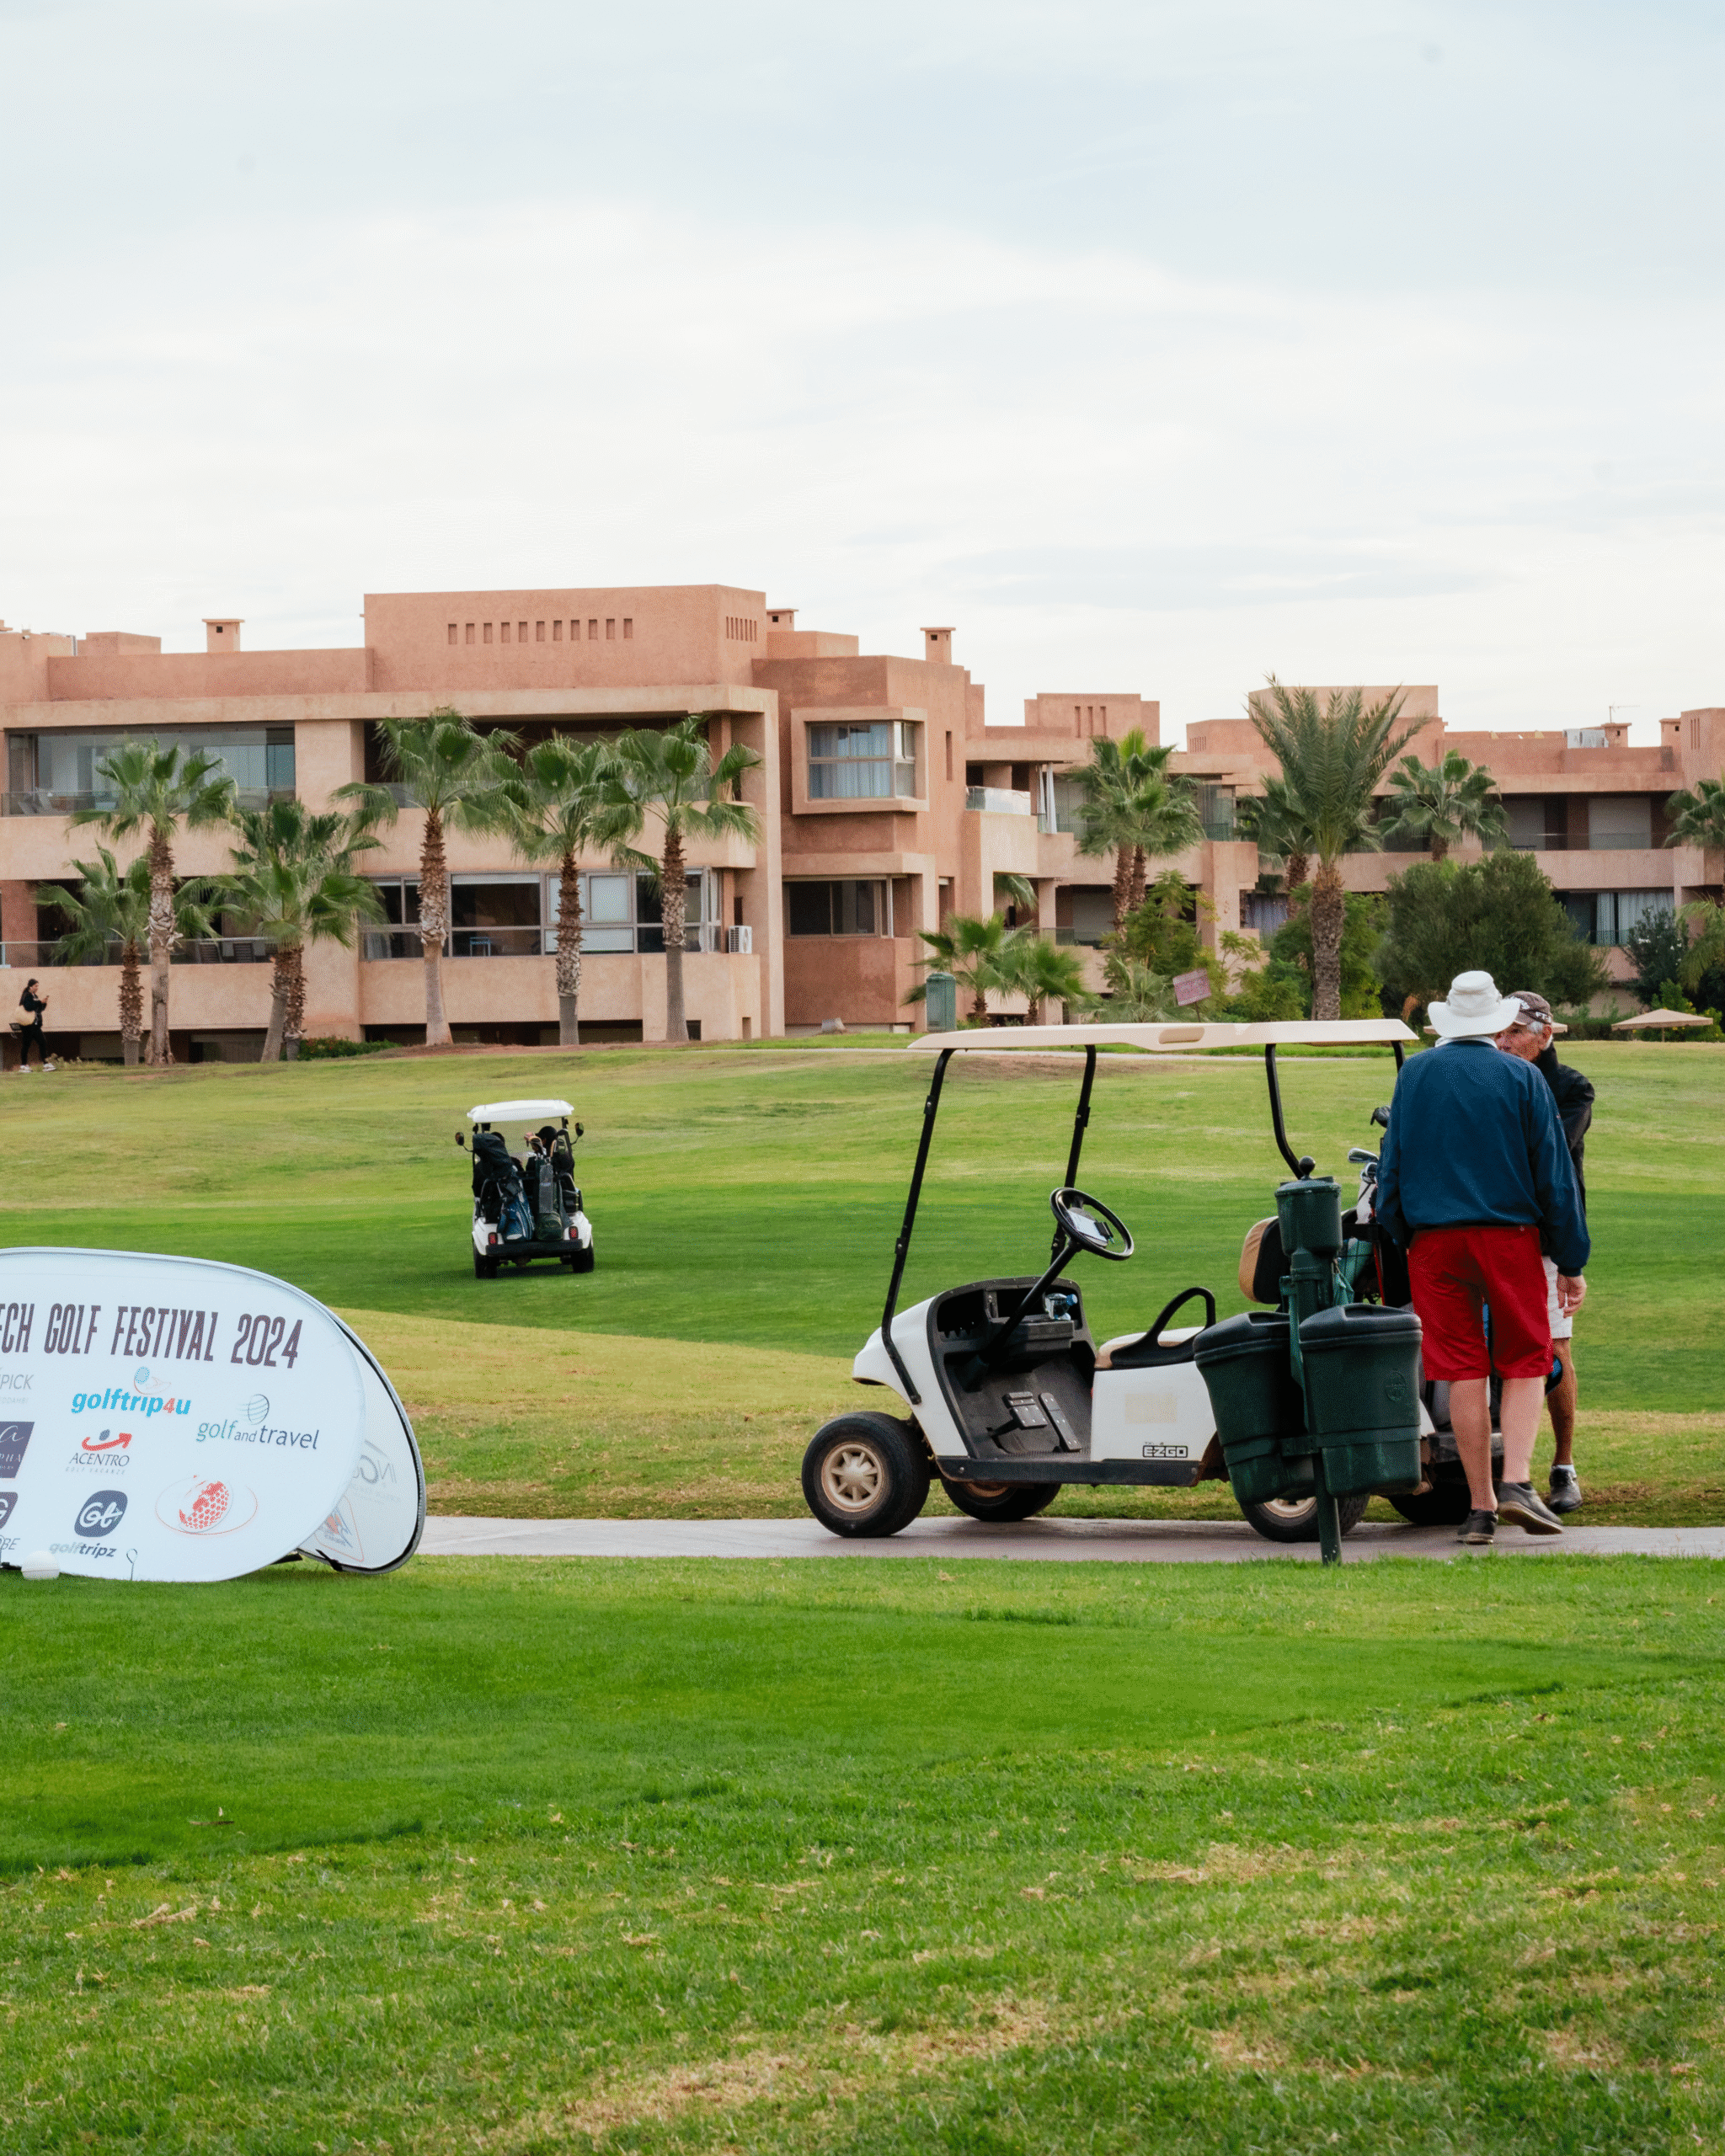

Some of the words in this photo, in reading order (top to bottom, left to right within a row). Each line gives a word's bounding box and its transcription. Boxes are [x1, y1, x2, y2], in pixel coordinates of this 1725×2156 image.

[44, 1303, 101, 1354] GOLF
[110, 1305, 218, 1362] FESTIVAL
[230, 1313, 303, 1369] 2024
[0, 1374, 35, 1390] PICK
[71, 1388, 191, 1417] golftrip4u
[68, 1452, 130, 1467] ACENTRO
[0, 1537, 20, 1550] BE
[49, 1541, 117, 1559] golftripz
